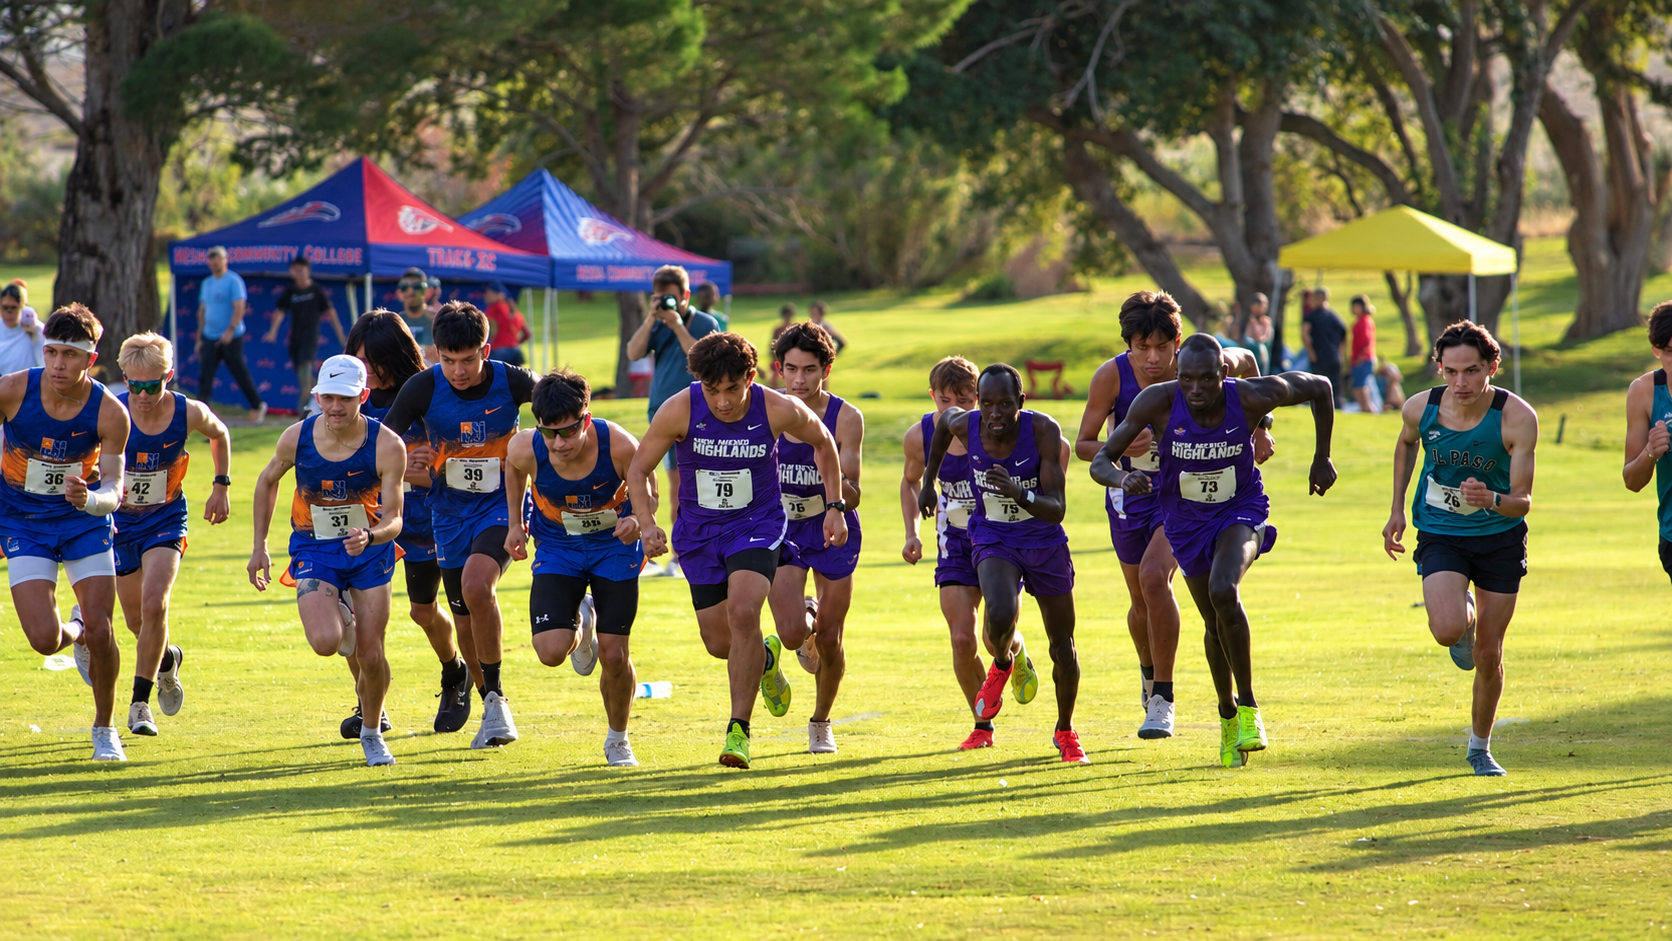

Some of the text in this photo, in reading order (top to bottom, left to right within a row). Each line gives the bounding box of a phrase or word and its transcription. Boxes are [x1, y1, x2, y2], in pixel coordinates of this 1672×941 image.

[303, 244, 363, 266] COLLEGE
[693, 441, 767, 458] HIGHLANDS
[1171, 443, 1244, 460] HIGHLANDS
[1449, 449, 1497, 472] PASO
[44, 473, 64, 485] 36
[463, 468, 483, 482] 39
[131, 482, 150, 495] 42
[715, 483, 733, 498] 79
[1200, 481, 1218, 493] 73
[1443, 491, 1460, 508] 26
[1001, 503, 1019, 515] 75
[330, 514, 349, 528] 37
